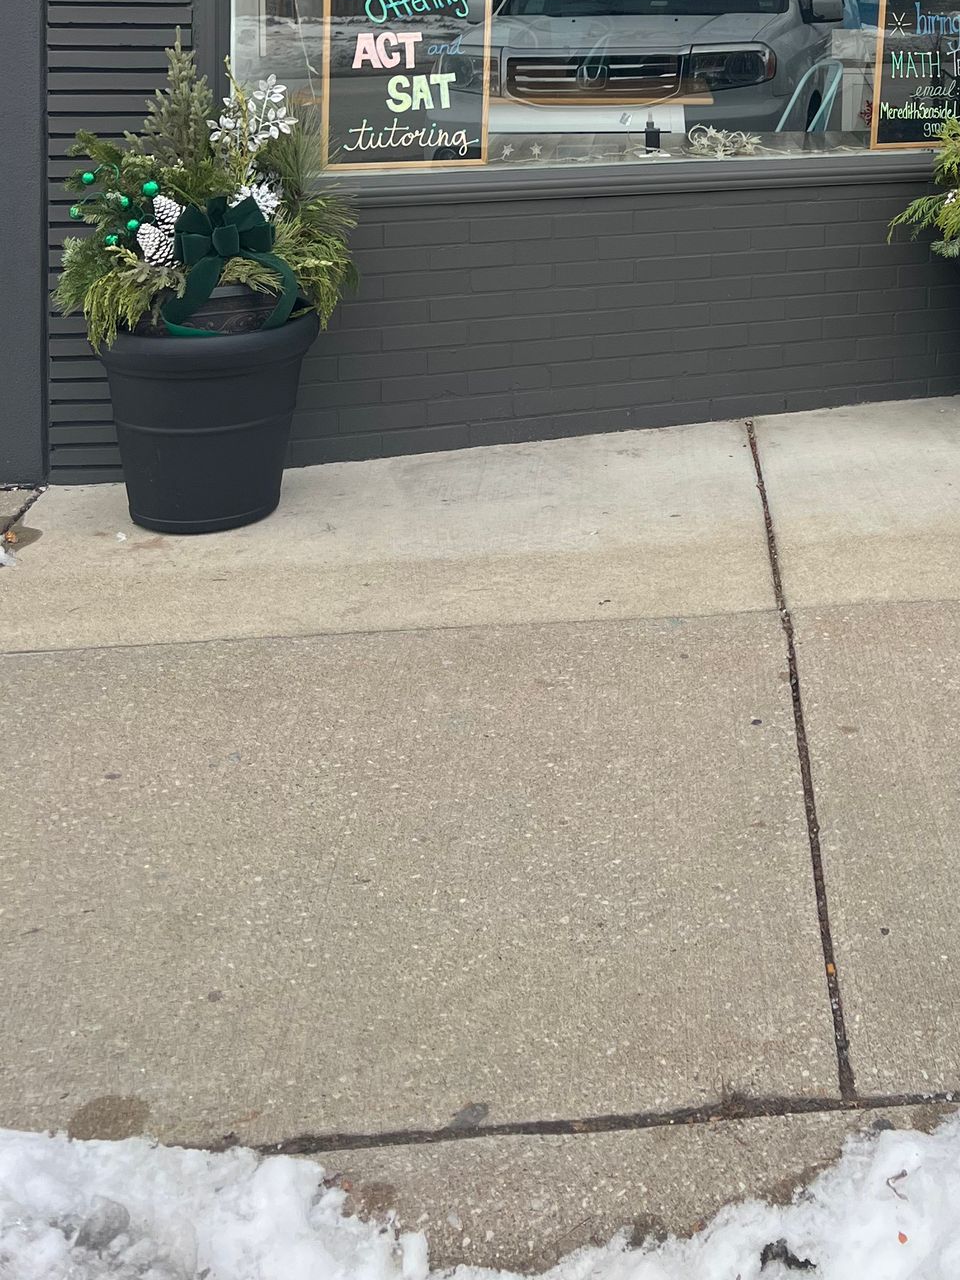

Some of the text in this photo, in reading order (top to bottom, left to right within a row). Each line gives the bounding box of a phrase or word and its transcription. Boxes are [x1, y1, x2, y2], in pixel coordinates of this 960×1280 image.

[351, 31, 466, 70] ACT and
[890, 50, 942, 79] MATH
[385, 72, 457, 113] SAT
[909, 79, 960, 98] email:
[343, 117, 480, 156] tutoring
